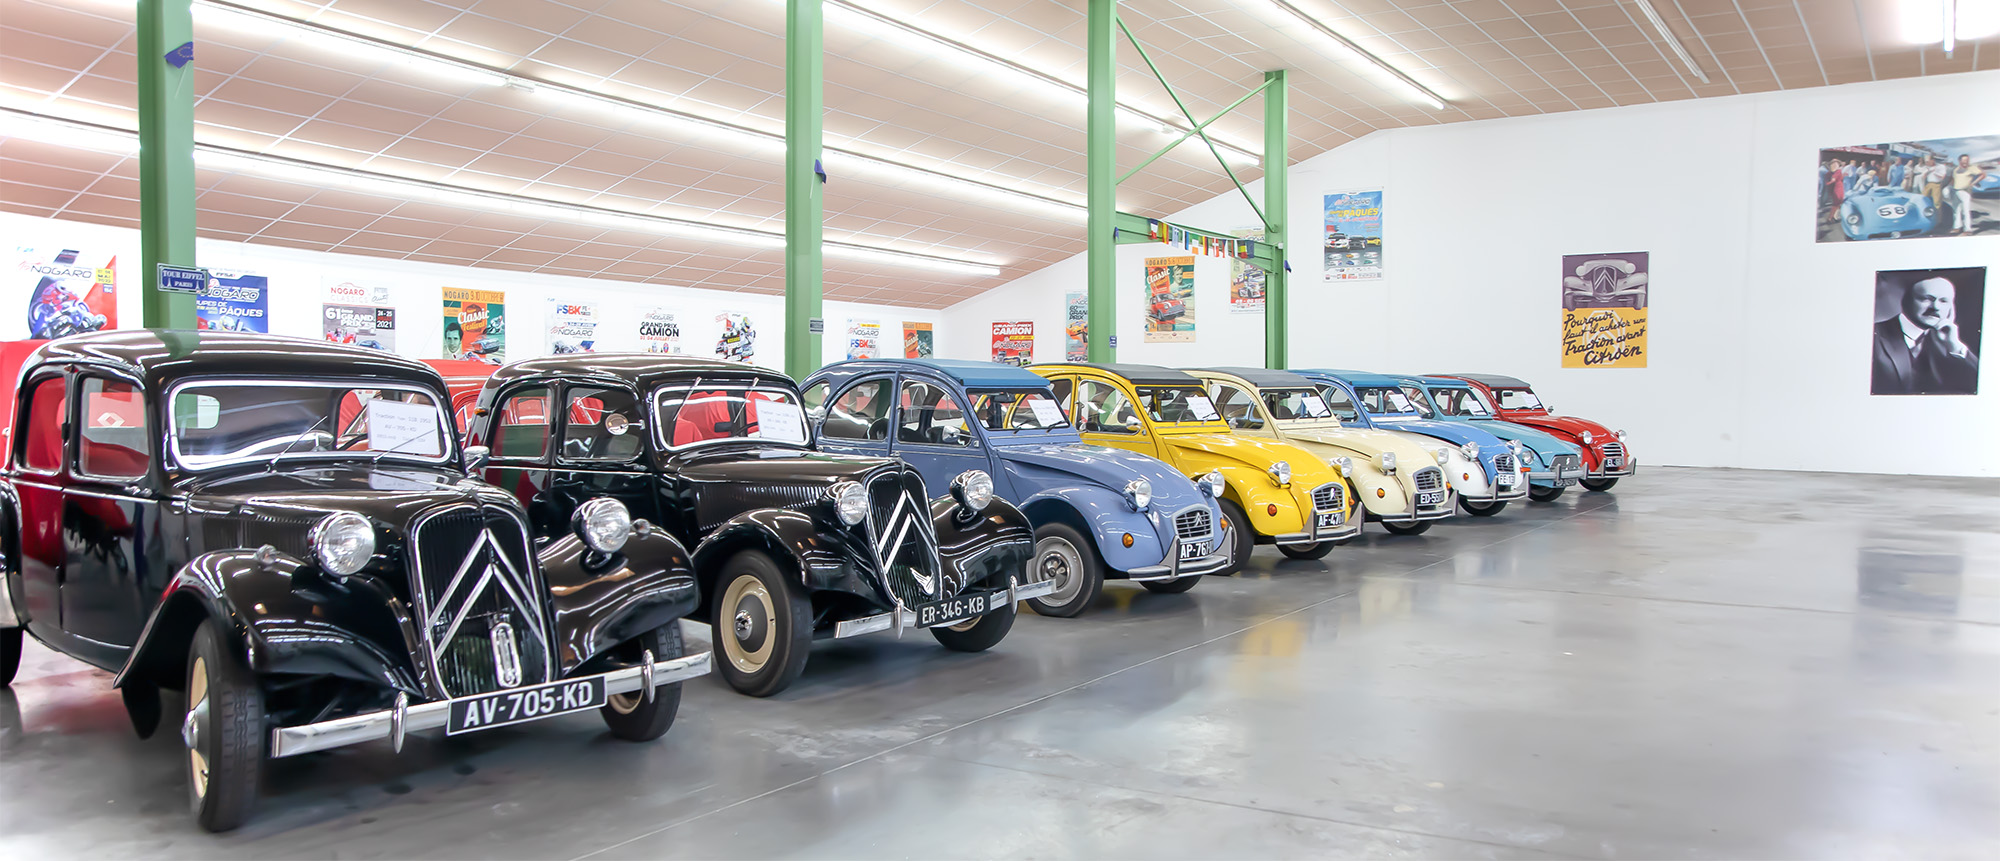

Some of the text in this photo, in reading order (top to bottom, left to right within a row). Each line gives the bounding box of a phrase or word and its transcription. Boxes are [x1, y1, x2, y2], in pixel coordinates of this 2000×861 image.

[1343, 206, 1379, 217] PÂQUES
[1879, 206, 1907, 216] 58
[31, 265, 92, 279] NOGARO
[163, 270, 205, 280] TOUR EIFFEL
[330, 287, 365, 296] NOGARO
[444, 290, 469, 300] NOGARO
[219, 306, 263, 318] PÂQUES
[325, 306, 341, 320] 61
[556, 304, 581, 315] FSBK
[457, 308, 490, 324] Classic
[1564, 310, 1613, 331] Pourquoi
[377, 320, 392, 328] 2021
[1600, 317, 1631, 332] acheter
[558, 328, 593, 336] NOGARO
[640, 325, 679, 337] CAMION
[993, 327, 1032, 336] CAMION
[850, 339, 869, 348] FSBK
[1565, 326, 1646, 356] Traction avant
[1584, 345, 1642, 366] Citroën
[922, 596, 984, 624] ER-346-KB
[463, 681, 593, 728] AV-705-KD
